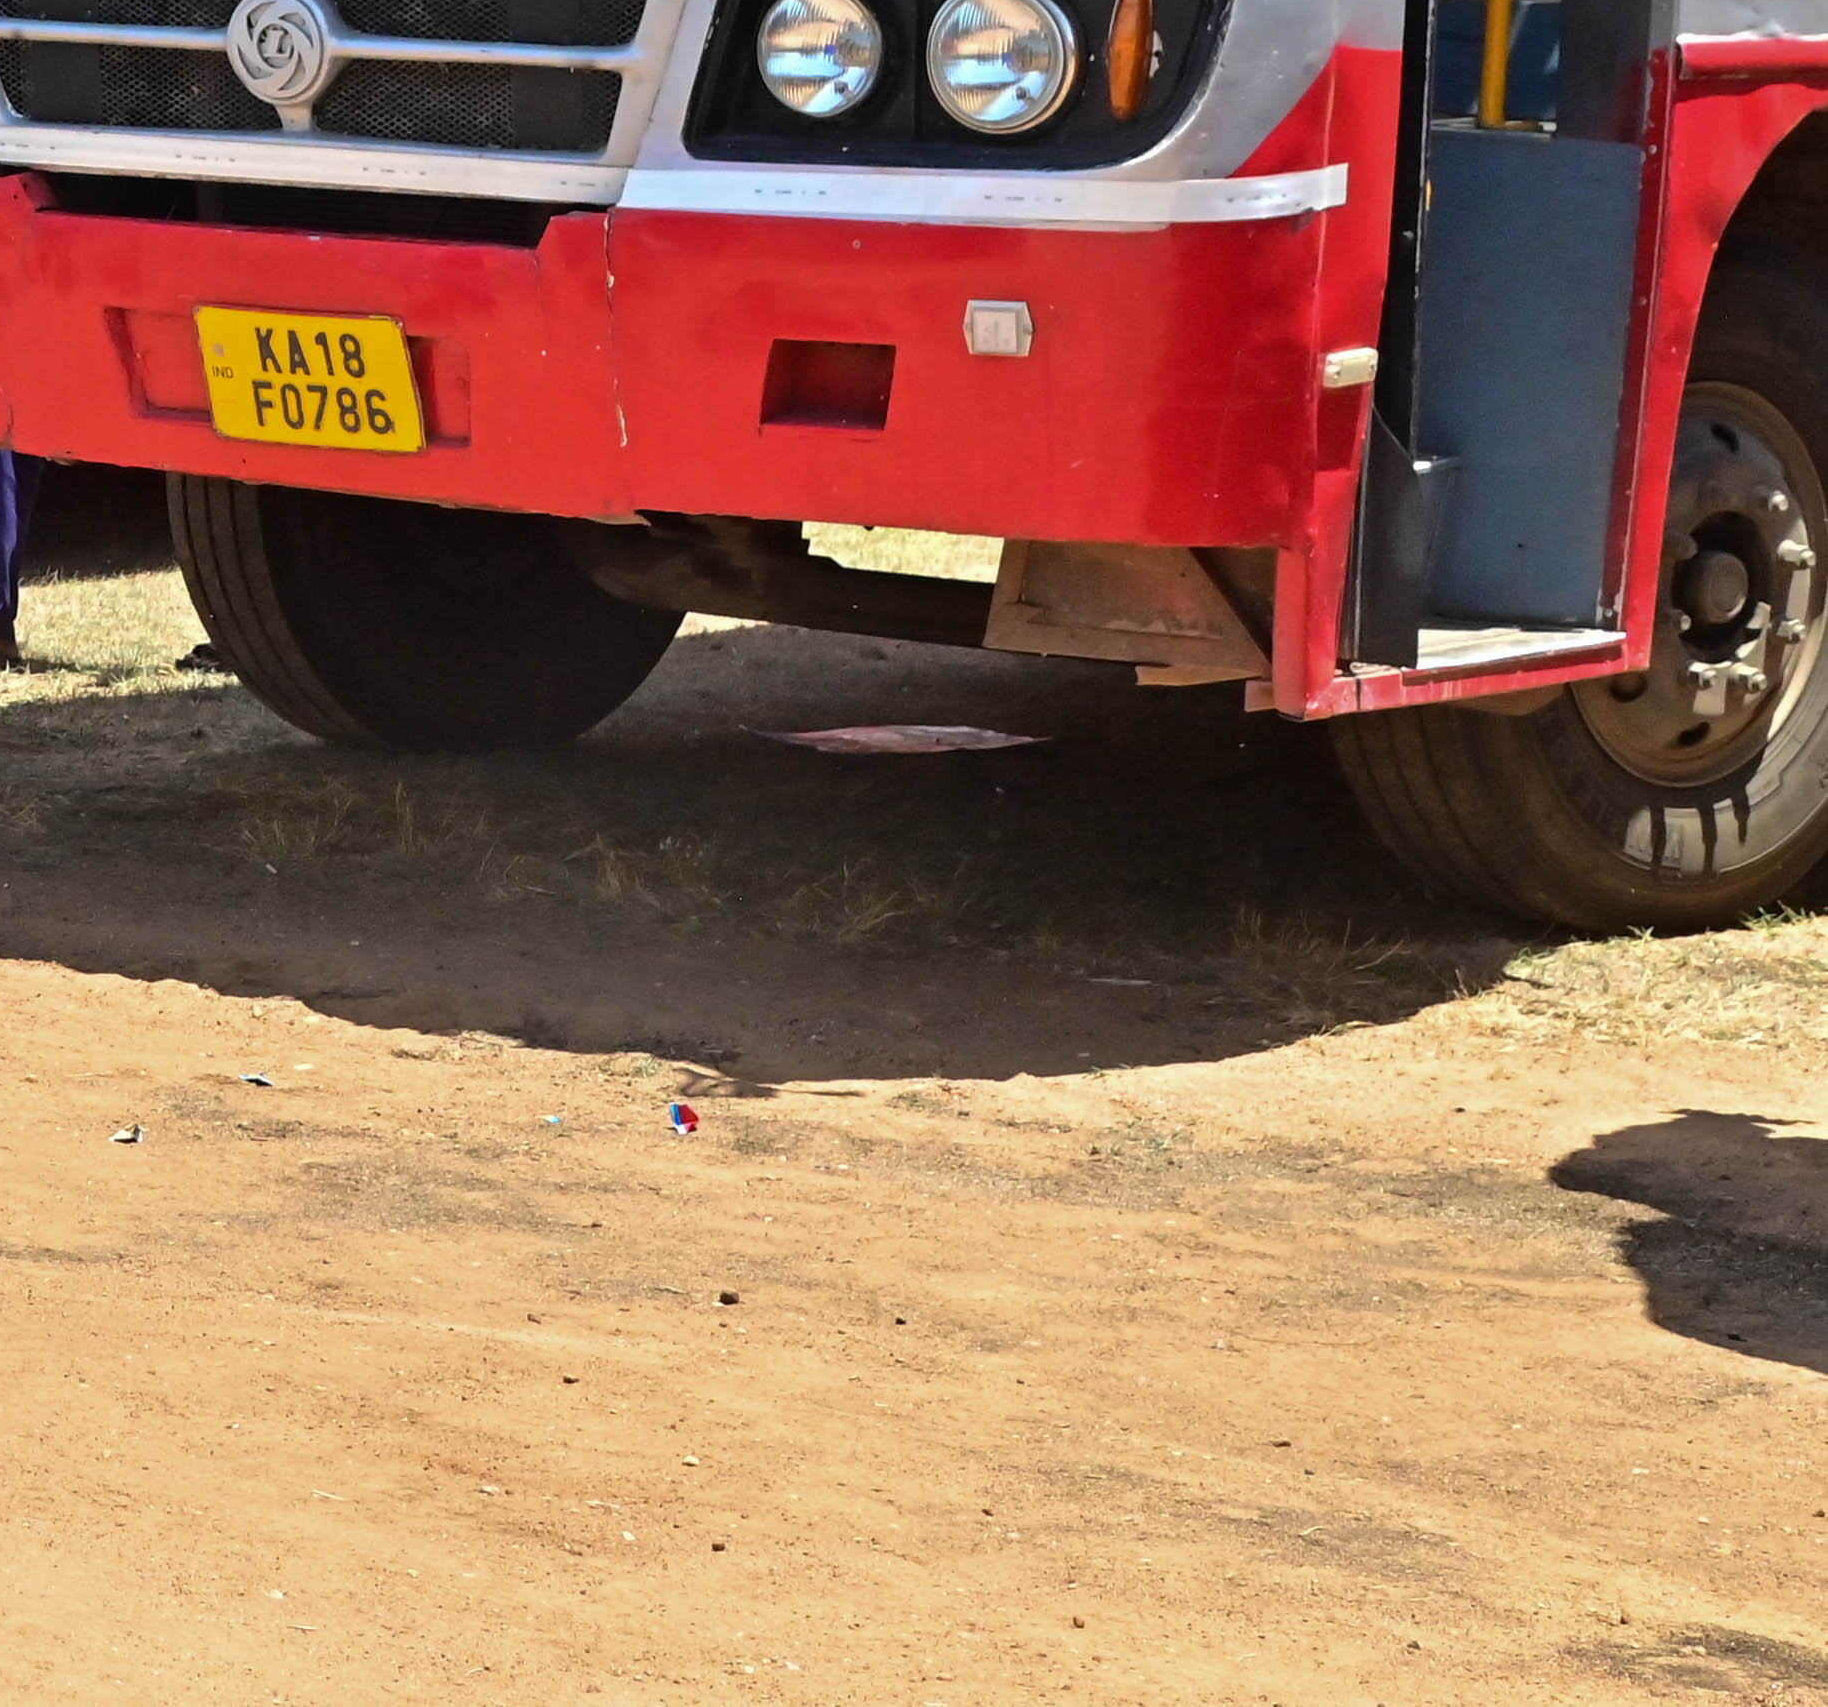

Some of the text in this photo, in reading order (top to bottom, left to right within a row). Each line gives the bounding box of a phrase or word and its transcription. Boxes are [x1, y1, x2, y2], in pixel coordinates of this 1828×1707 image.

[212, 365, 234, 379] IND
[254, 326, 366, 379] KA18
[251, 380, 393, 435] F0786
